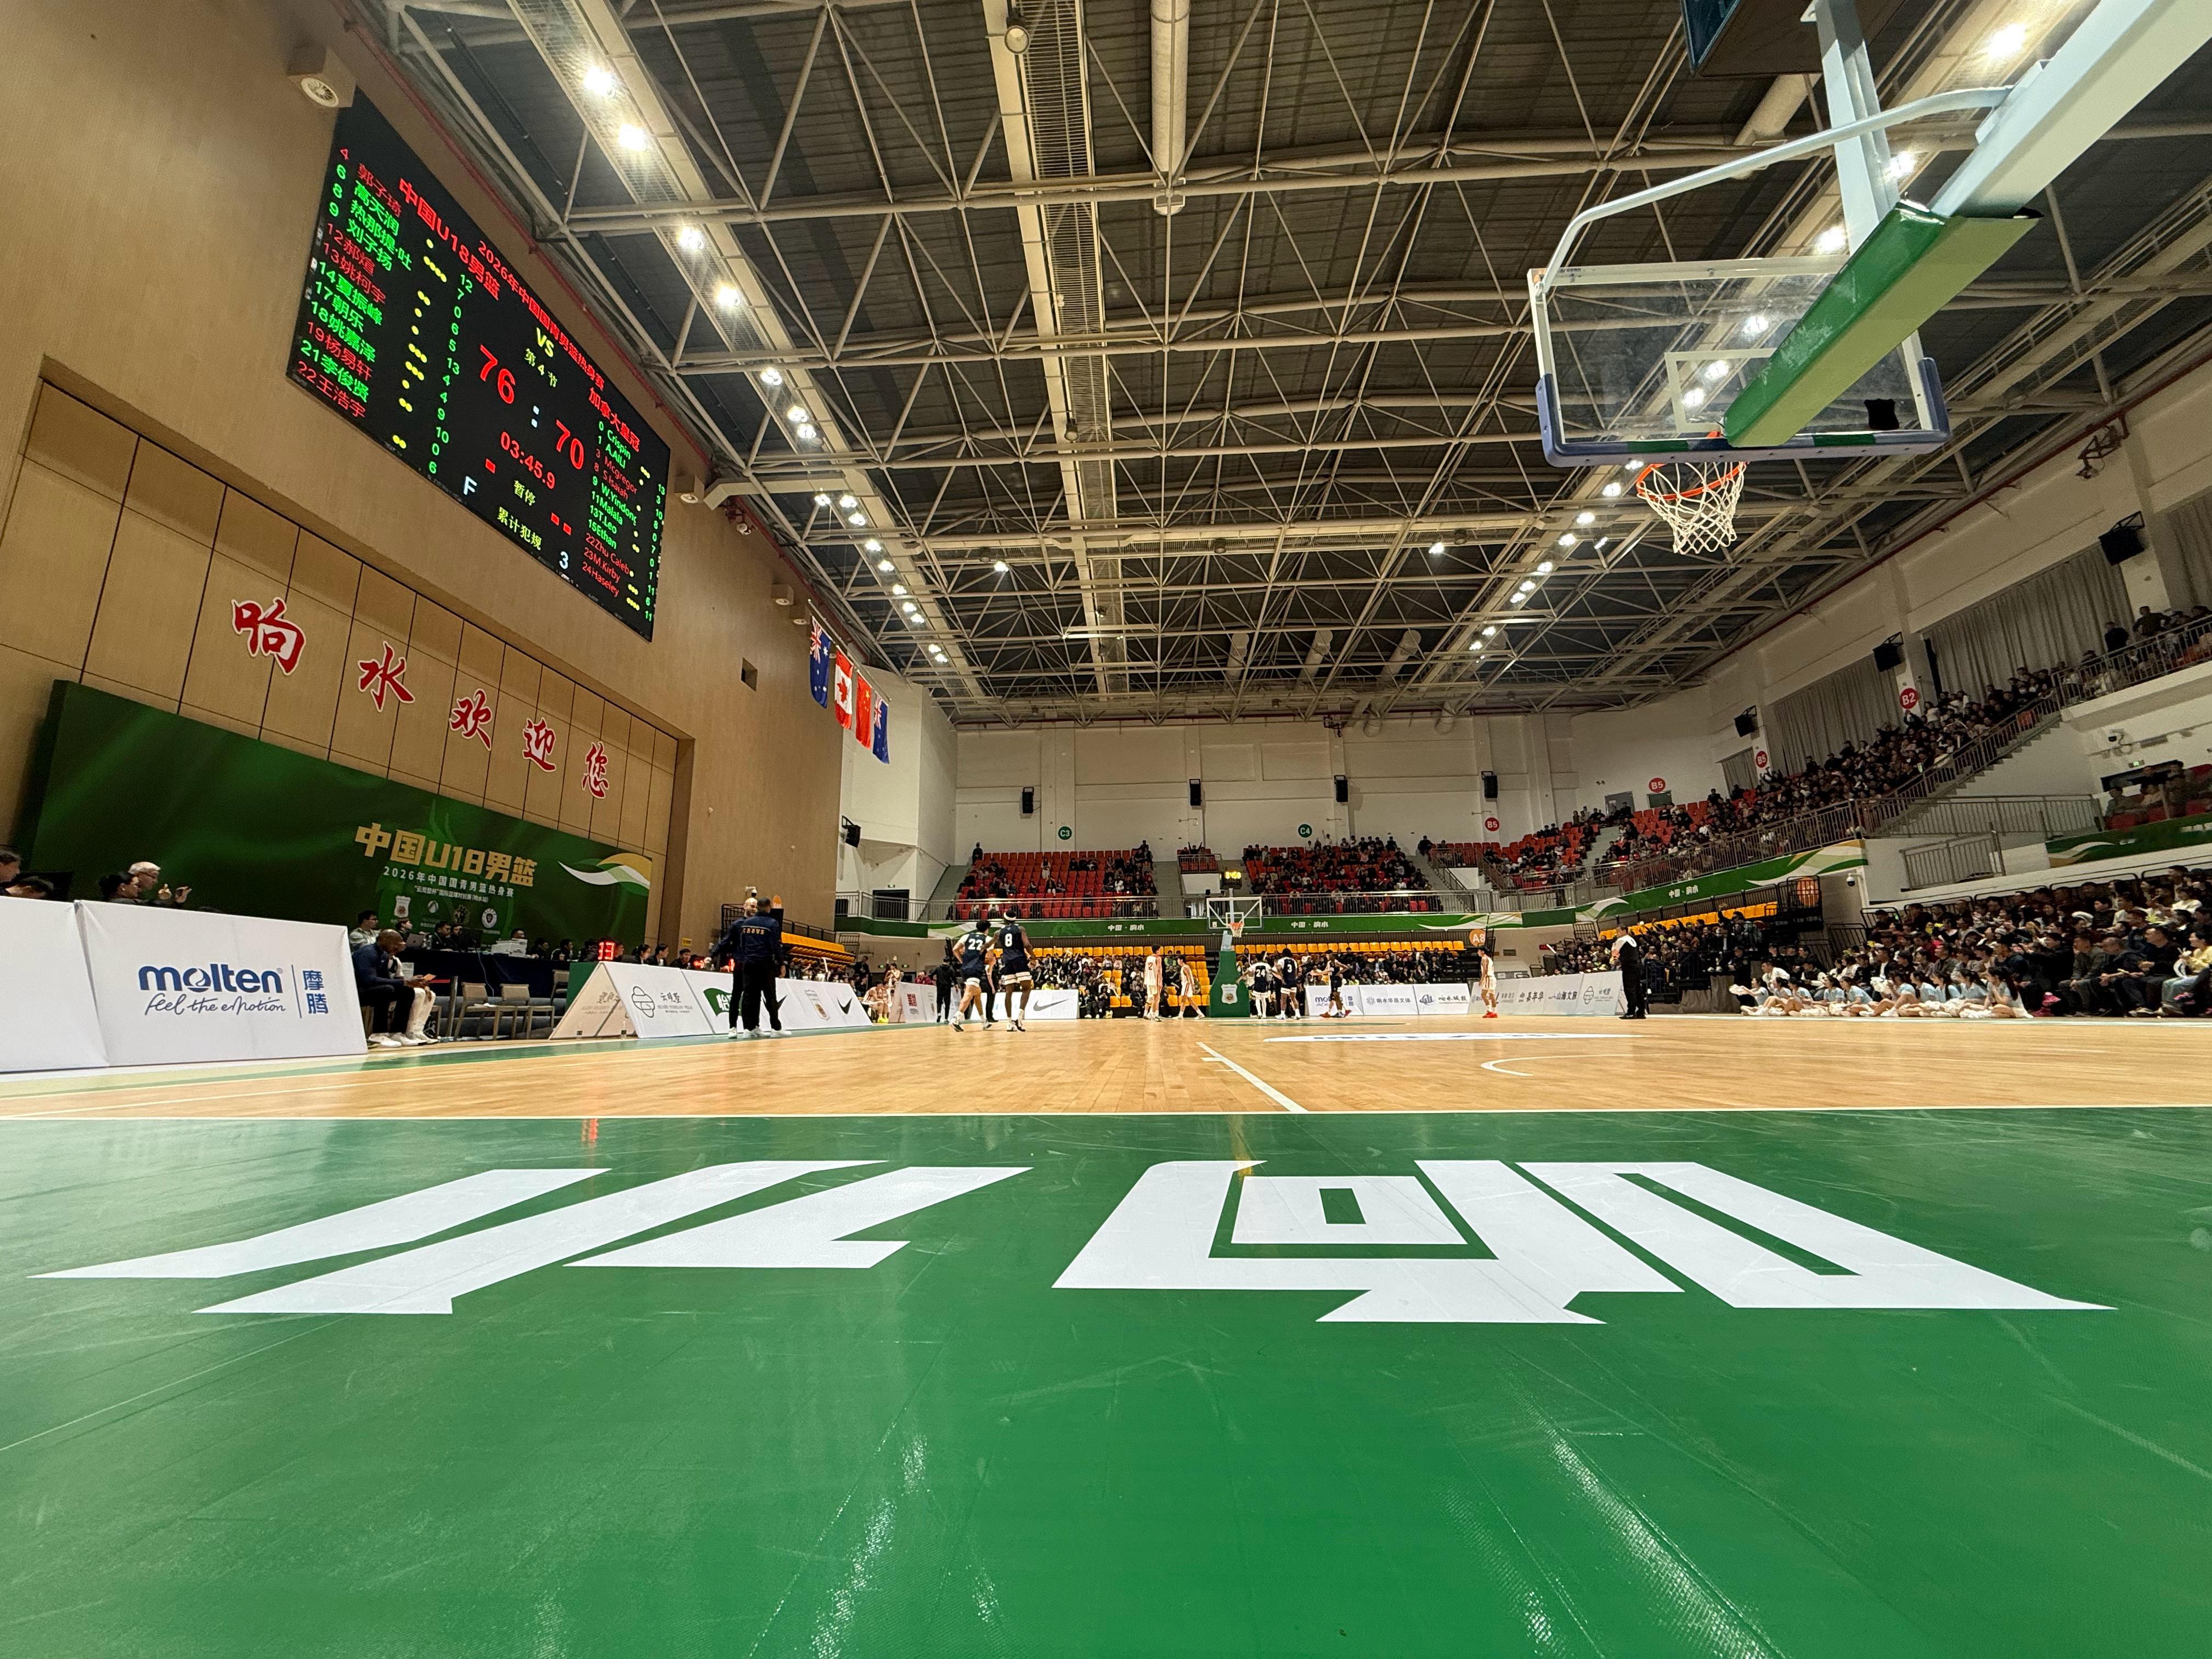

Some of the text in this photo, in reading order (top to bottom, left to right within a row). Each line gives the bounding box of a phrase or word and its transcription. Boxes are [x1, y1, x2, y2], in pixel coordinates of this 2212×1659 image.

[336, 165, 464, 300] 6 高天润 7
[340, 148, 349, 160] 4
[461, 274, 472, 294] 12
[333, 183, 342, 199] 8
[454, 306, 461, 319] 0
[399, 178, 500, 301] 中国U18男篮
[329, 202, 459, 335] 9 刘子扬 6
[478, 240, 605, 391] 2026年中国国青男篮热身赛
[449, 338, 456, 352] 5
[536, 327, 554, 357] VS
[447, 358, 460, 375] 13
[443, 375, 450, 386] 4
[440, 392, 448, 403] 4
[479, 345, 516, 404] 76
[556, 419, 585, 470] 70
[438, 408, 445, 420] 9
[589, 387, 640, 452] 加拿大皇冠
[436, 427, 449, 443] 10
[432, 443, 439, 455] 0
[500, 431, 556, 489] 03:45.9
[599, 421, 665, 495] 0 Crispin 13
[429, 461, 437, 474] 6
[594, 462, 599, 472] 8
[598, 436, 602, 444] 1
[656, 495, 661, 505] 3
[464, 476, 477, 495] F
[514, 481, 535, 506] 暂停
[596, 448, 663, 521] 3 Mcgregor 10
[592, 476, 598, 486] 9
[652, 533, 657, 542] 0
[497, 506, 542, 551] 累计犯规
[559, 551, 569, 569] 3
[651, 545, 656, 554] 7
[650, 558, 654, 567] 0
[610, 553, 630, 575] Caleb
[647, 584, 654, 596] 11
[649, 572, 653, 580] 1
[645, 611, 652, 622] 11
[1902, 692, 1916, 706] B2
[354, 822, 538, 887] 中国U18男篮
[383, 866, 514, 898] 2026年中国国青男篮热身赛
[968, 938, 983, 950] 22
[1005, 933, 1012, 947] 8
[1256, 969, 1266, 977] 24
[1287, 964, 1293, 973] 3
[144, 992, 186, 1015] feel
[187, 997, 218, 1013] the
[302, 970, 329, 1014] 摩腾
